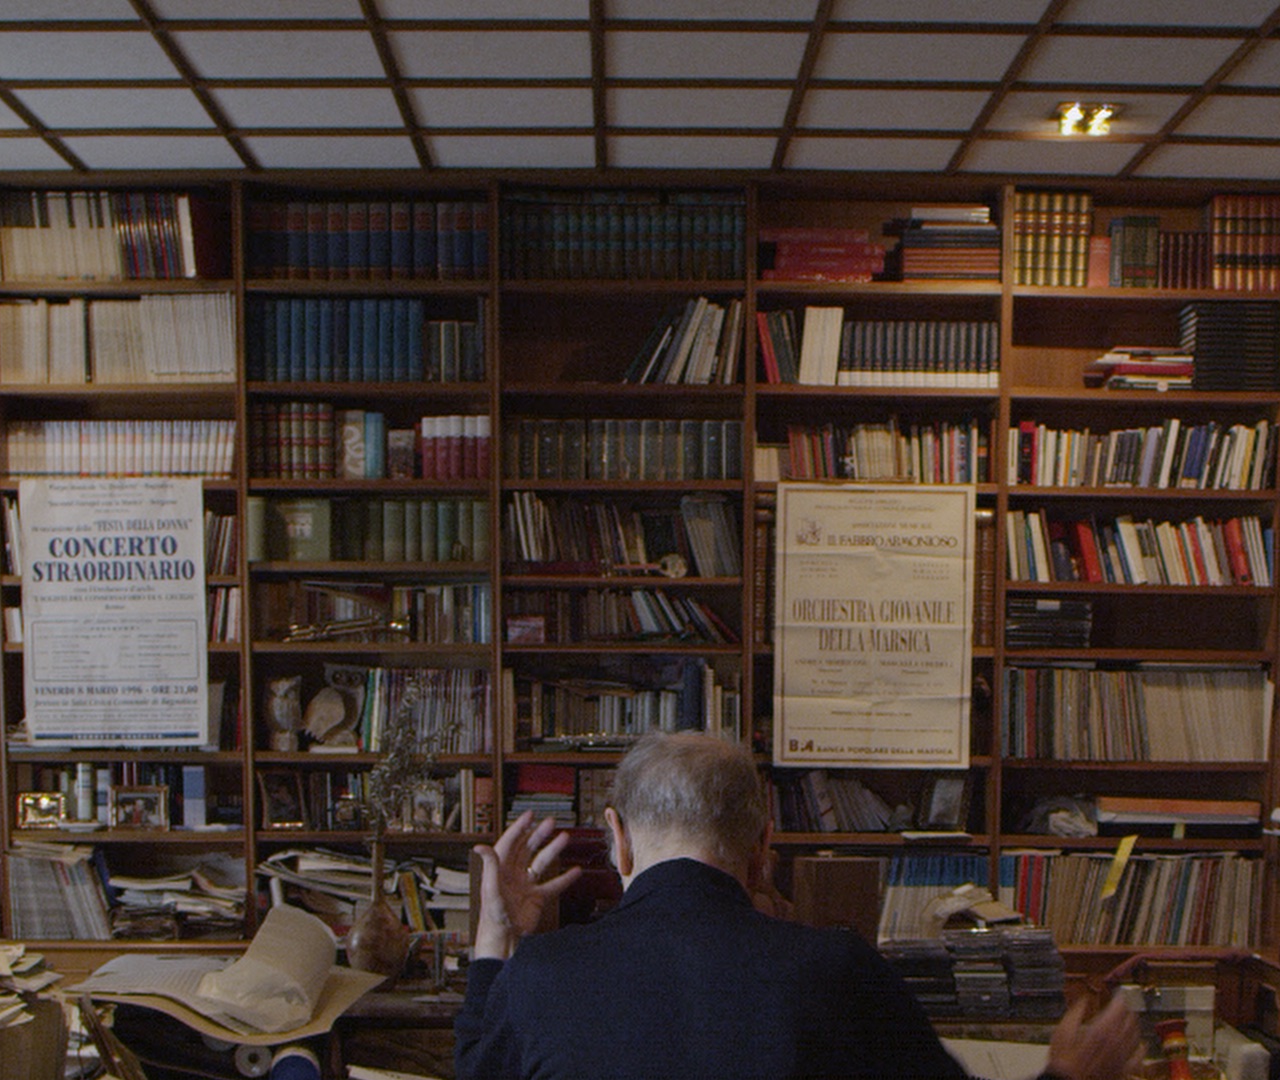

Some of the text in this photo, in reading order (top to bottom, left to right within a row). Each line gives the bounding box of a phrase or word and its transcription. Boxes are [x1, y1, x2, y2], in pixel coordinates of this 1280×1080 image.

[48, 535, 178, 558] CONCERTO
[839, 535, 884, 547] FABBRO
[883, 536, 958, 548] ARMONIOSO
[32, 559, 195, 583] STRAORDINARIO
[792, 600, 955, 623] ORCHESTRA GIOVANILE
[818, 629, 931, 652] DELLA MARSICA
[86, 686, 119, 695] MARZO
[151, 686, 171, 695] ORE
